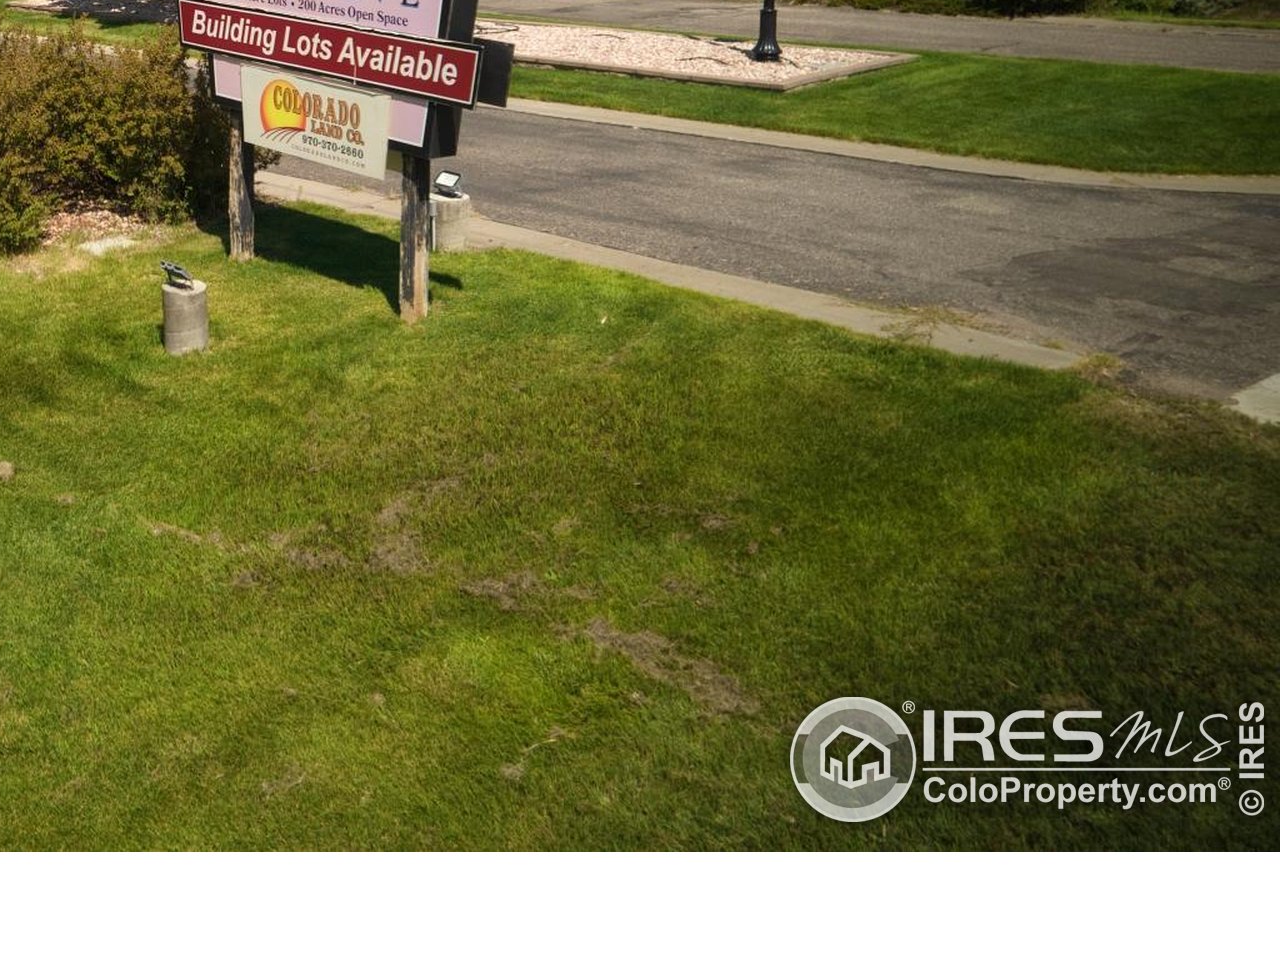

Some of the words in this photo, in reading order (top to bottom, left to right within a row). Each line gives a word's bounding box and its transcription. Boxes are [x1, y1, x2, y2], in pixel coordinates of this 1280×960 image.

[298, 0, 317, 12] 200
[318, 2, 346, 17] Acres
[348, 6, 374, 22] Open
[377, 11, 409, 27] Space
[191, 10, 277, 55] Building
[282, 27, 333, 60] Lots
[337, 37, 458, 86] Available
[273, 85, 361, 129] COLORADO
[310, 119, 343, 140] LAND
